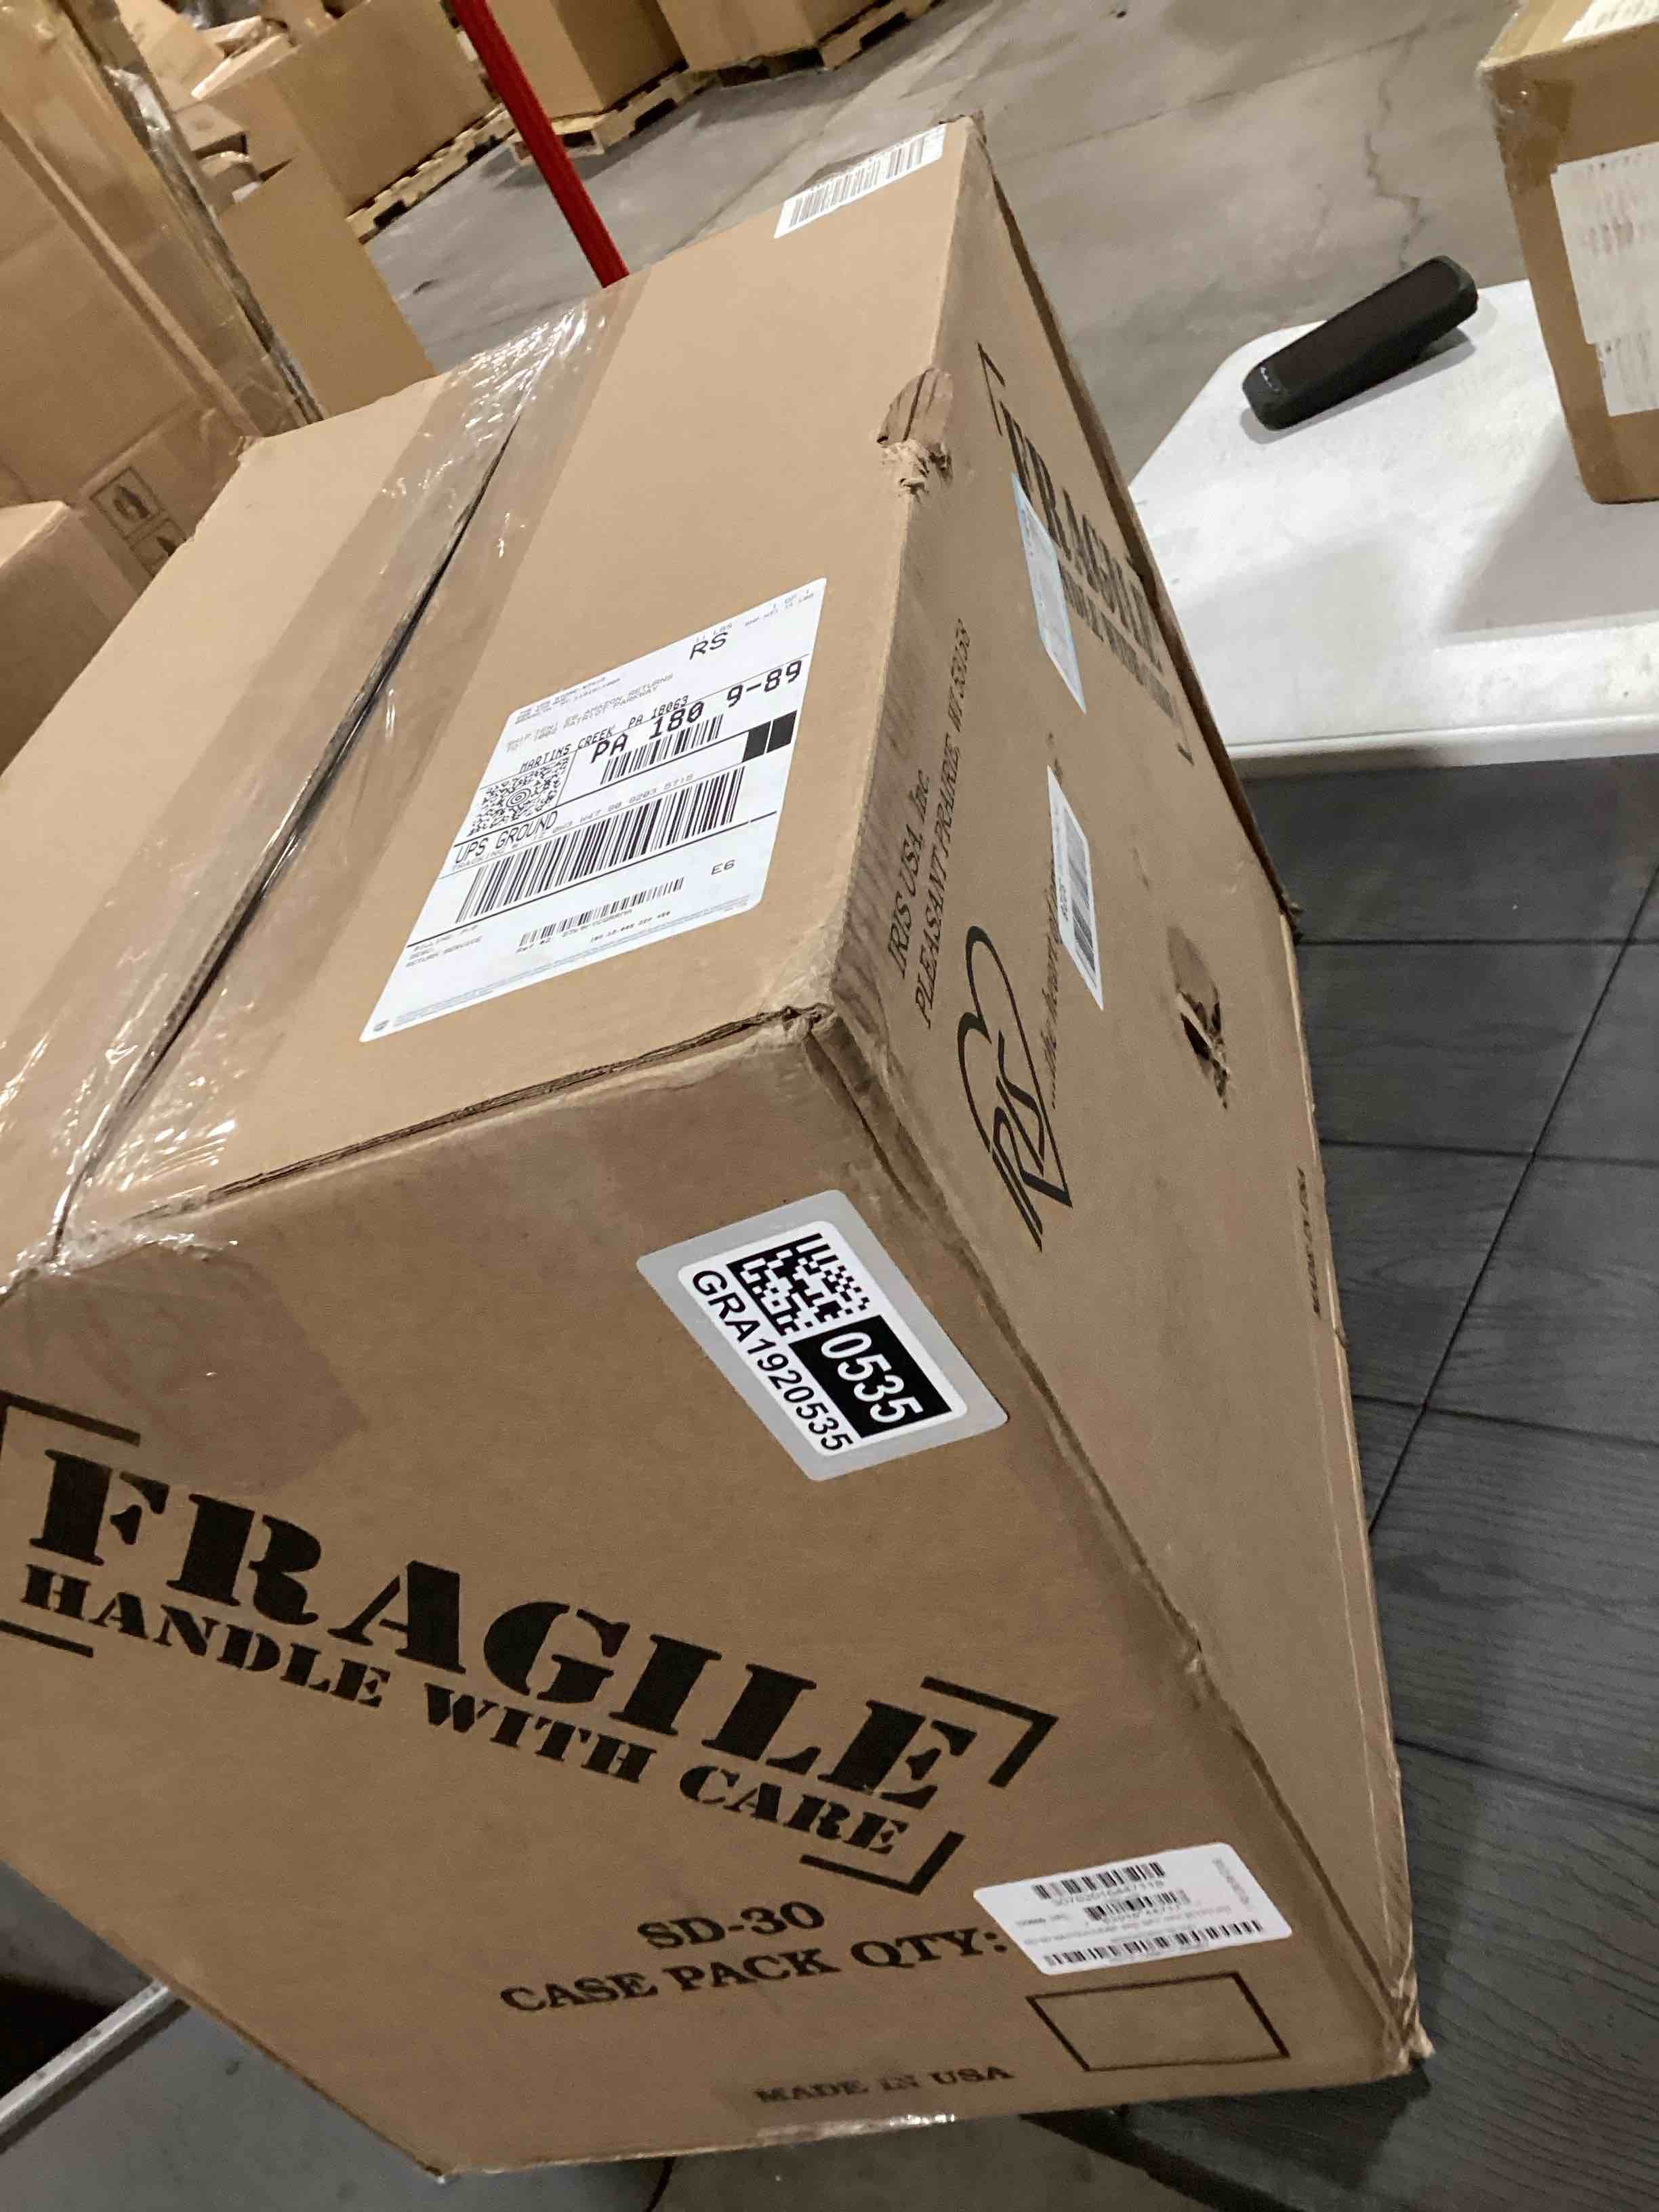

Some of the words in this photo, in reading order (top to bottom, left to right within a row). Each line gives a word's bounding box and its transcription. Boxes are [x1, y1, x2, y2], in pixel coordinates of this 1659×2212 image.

[689, 632, 729, 660] RS
[520, 743, 572, 774] MARTINS
[577, 724, 616, 750] CREEK
[627, 714, 644, 730] PA
[650, 695, 689, 720] 18063
[590, 732, 629, 764] PA
[649, 701, 705, 739] 180
[726, 659, 802, 708] 9-89
[455, 837, 489, 864] UPS
[495, 810, 558, 849] GROUND
[710, 859, 736, 876] E6
[888, 890, 912, 980] IRIS
[915, 843, 947, 1030] PLEASANT
[691, 1269, 854, 1452] GRA1920535
[820, 1331, 924, 1424] 0535
[29, 1449, 978, 1810] FRAGILE
[21, 1563, 391, 1708] HANDLE
[424, 1683, 657, 1784] WITH
[679, 1765, 909, 1856] CARE
[636, 1900, 825, 1950] SD-30
[499, 1971, 659, 2011] CASE
[661, 1948, 842, 1991] PACK
[849, 1927, 1009, 1969] QTY:
[753, 2079, 869, 2103] MADE
[880, 2074, 920, 2092] IN
[929, 2064, 1016, 2085] USA
